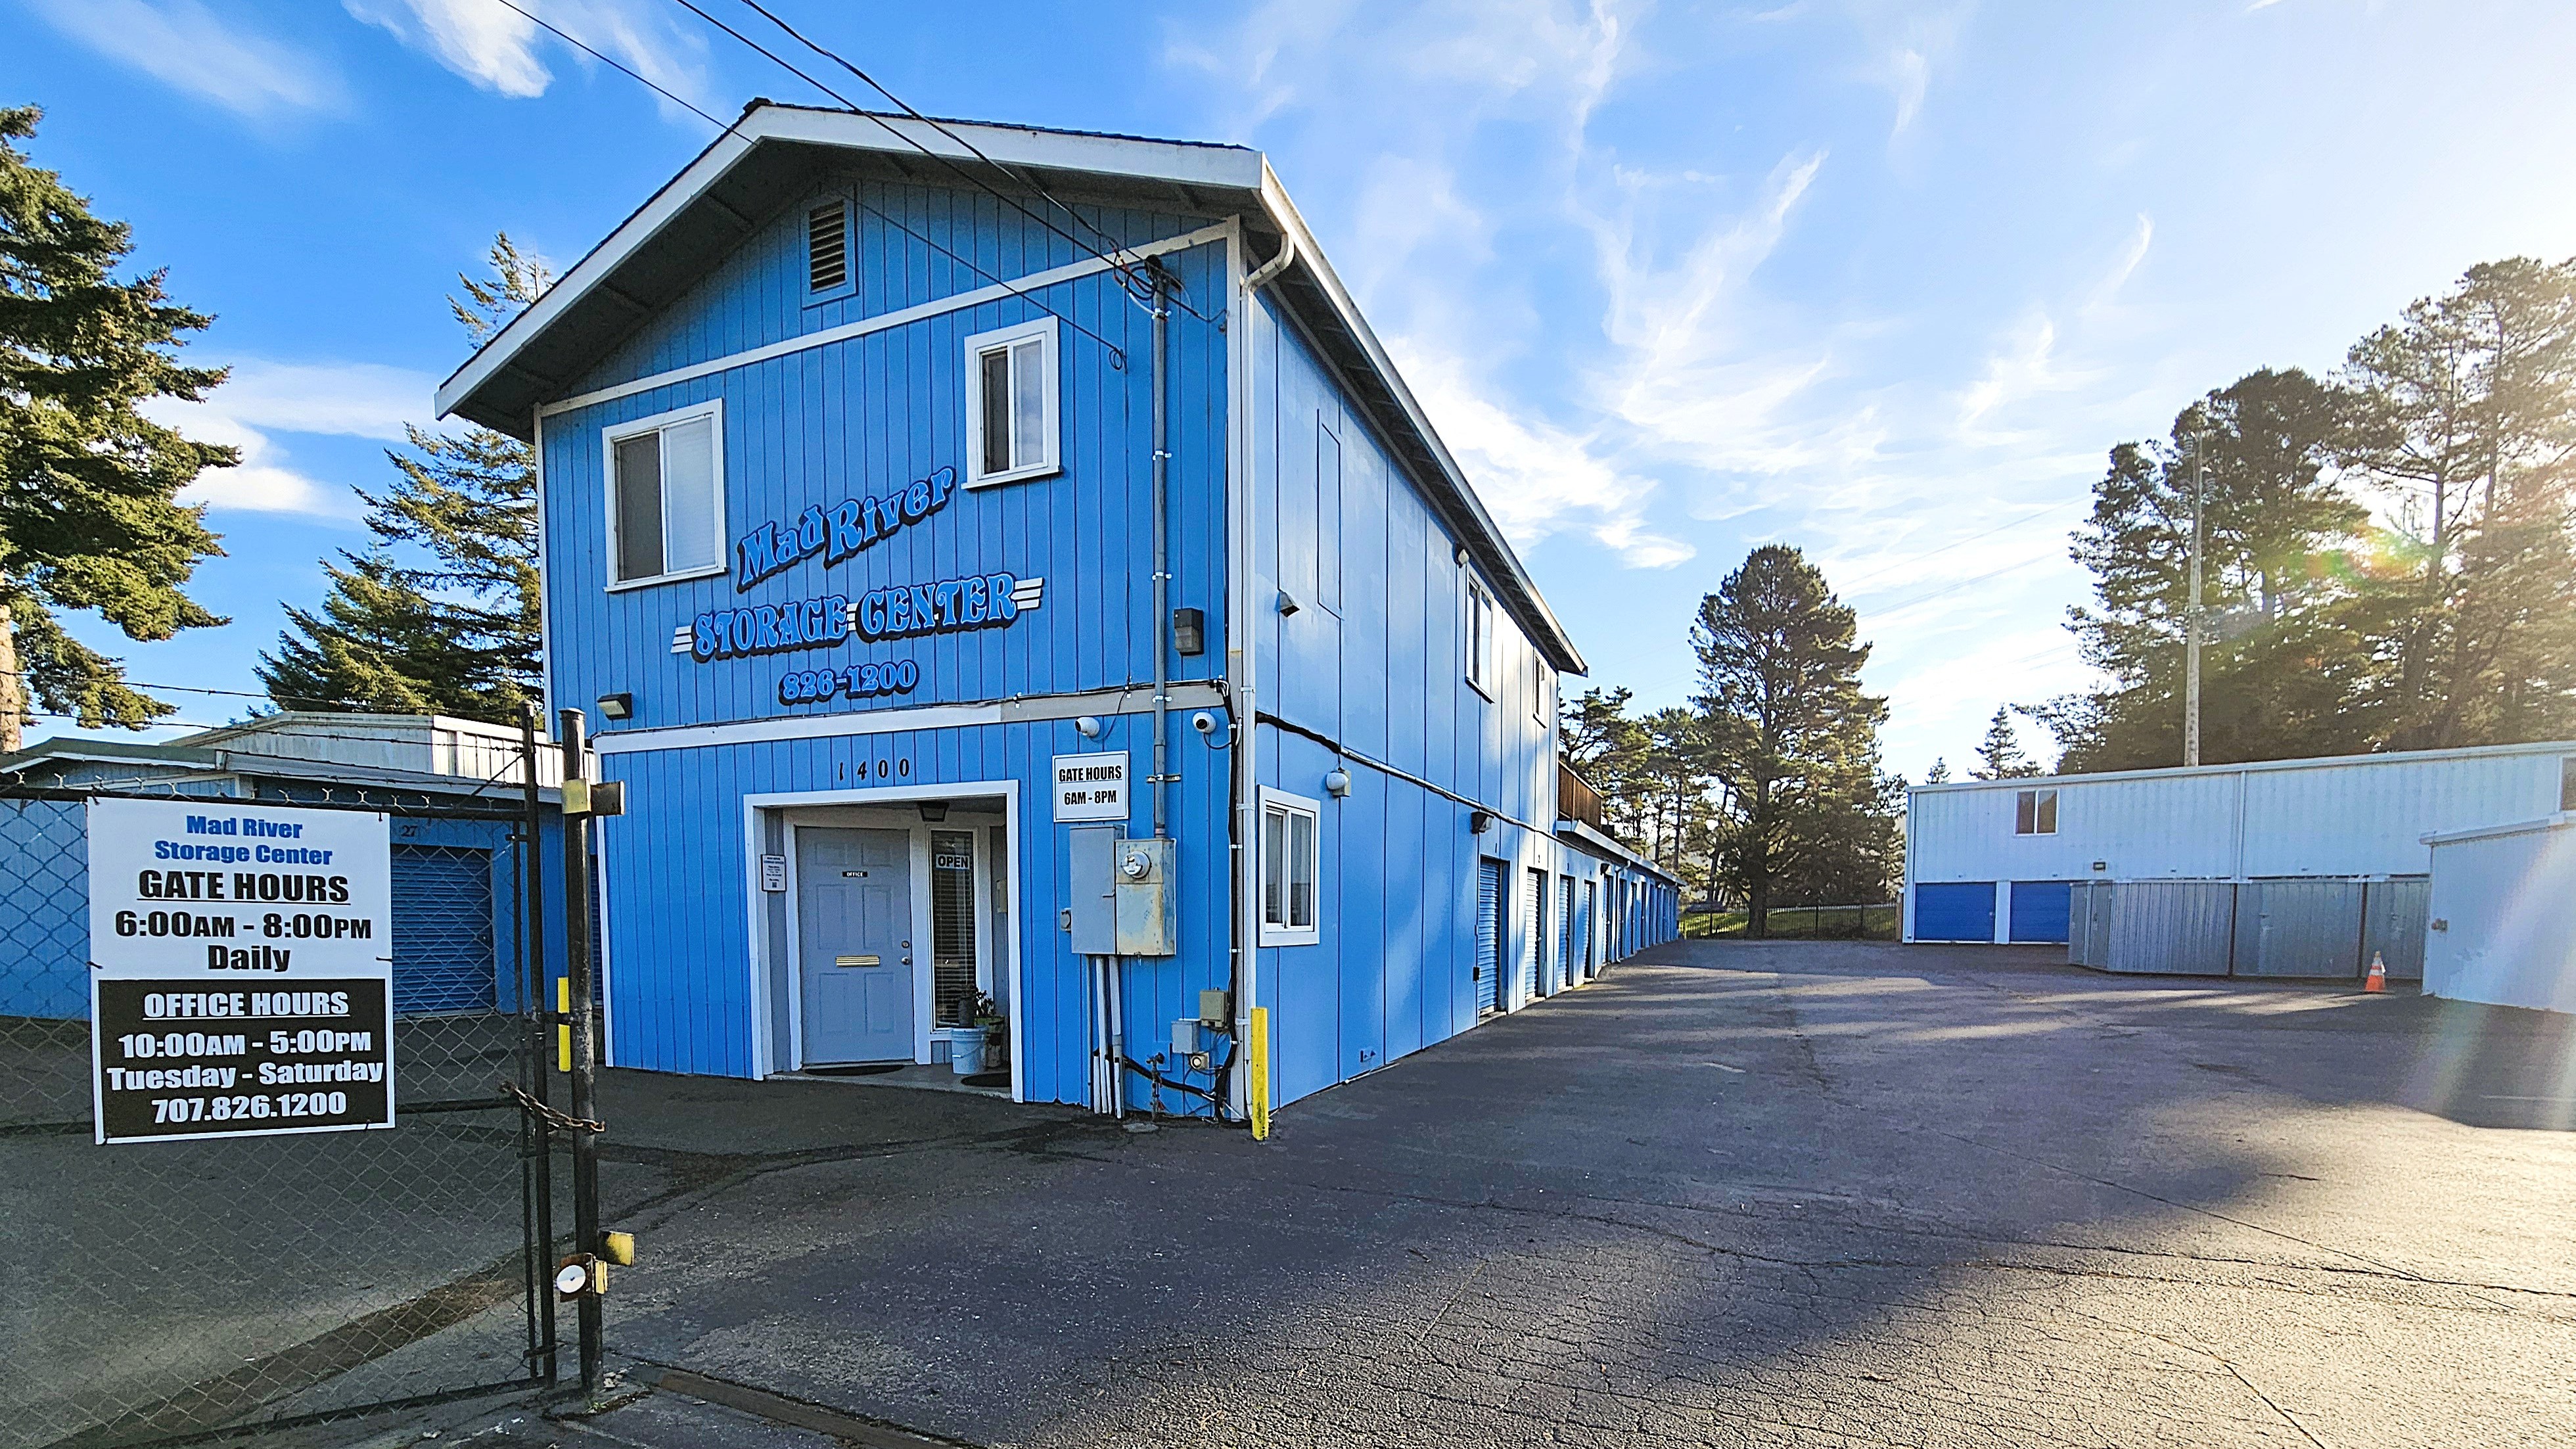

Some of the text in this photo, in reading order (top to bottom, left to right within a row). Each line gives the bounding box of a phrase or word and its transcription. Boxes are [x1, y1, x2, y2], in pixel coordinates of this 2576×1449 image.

[738, 465, 956, 593] Mad River
[693, 573, 1020, 660] STORAGE CENTER
[780, 660, 919, 703] 826-1200
[840, 758, 909, 781] 1400
[1059, 766, 1122, 782] GATE HOURS
[1064, 792, 1086, 805] 6AM
[1094, 790, 1116, 804] 8PM
[186, 815, 303, 839] Mad River
[401, 825, 418, 837] 27
[154, 840, 333, 865] Storage Center
[938, 856, 969, 867] OPEN
[139, 869, 350, 902] GATE HOURS
[115, 910, 235, 938] 6:00AM
[263, 913, 372, 940] 8:00PM
[208, 944, 290, 973] Daily
[144, 992, 350, 1017] OFFICE HOURS
[118, 1032, 246, 1058] 10:00AM
[270, 1030, 371, 1054] 5:00PM
[106, 1066, 237, 1091] Tuesday
[259, 1059, 384, 1085] Saturday
[151, 1091, 347, 1124] 707.826.1200
